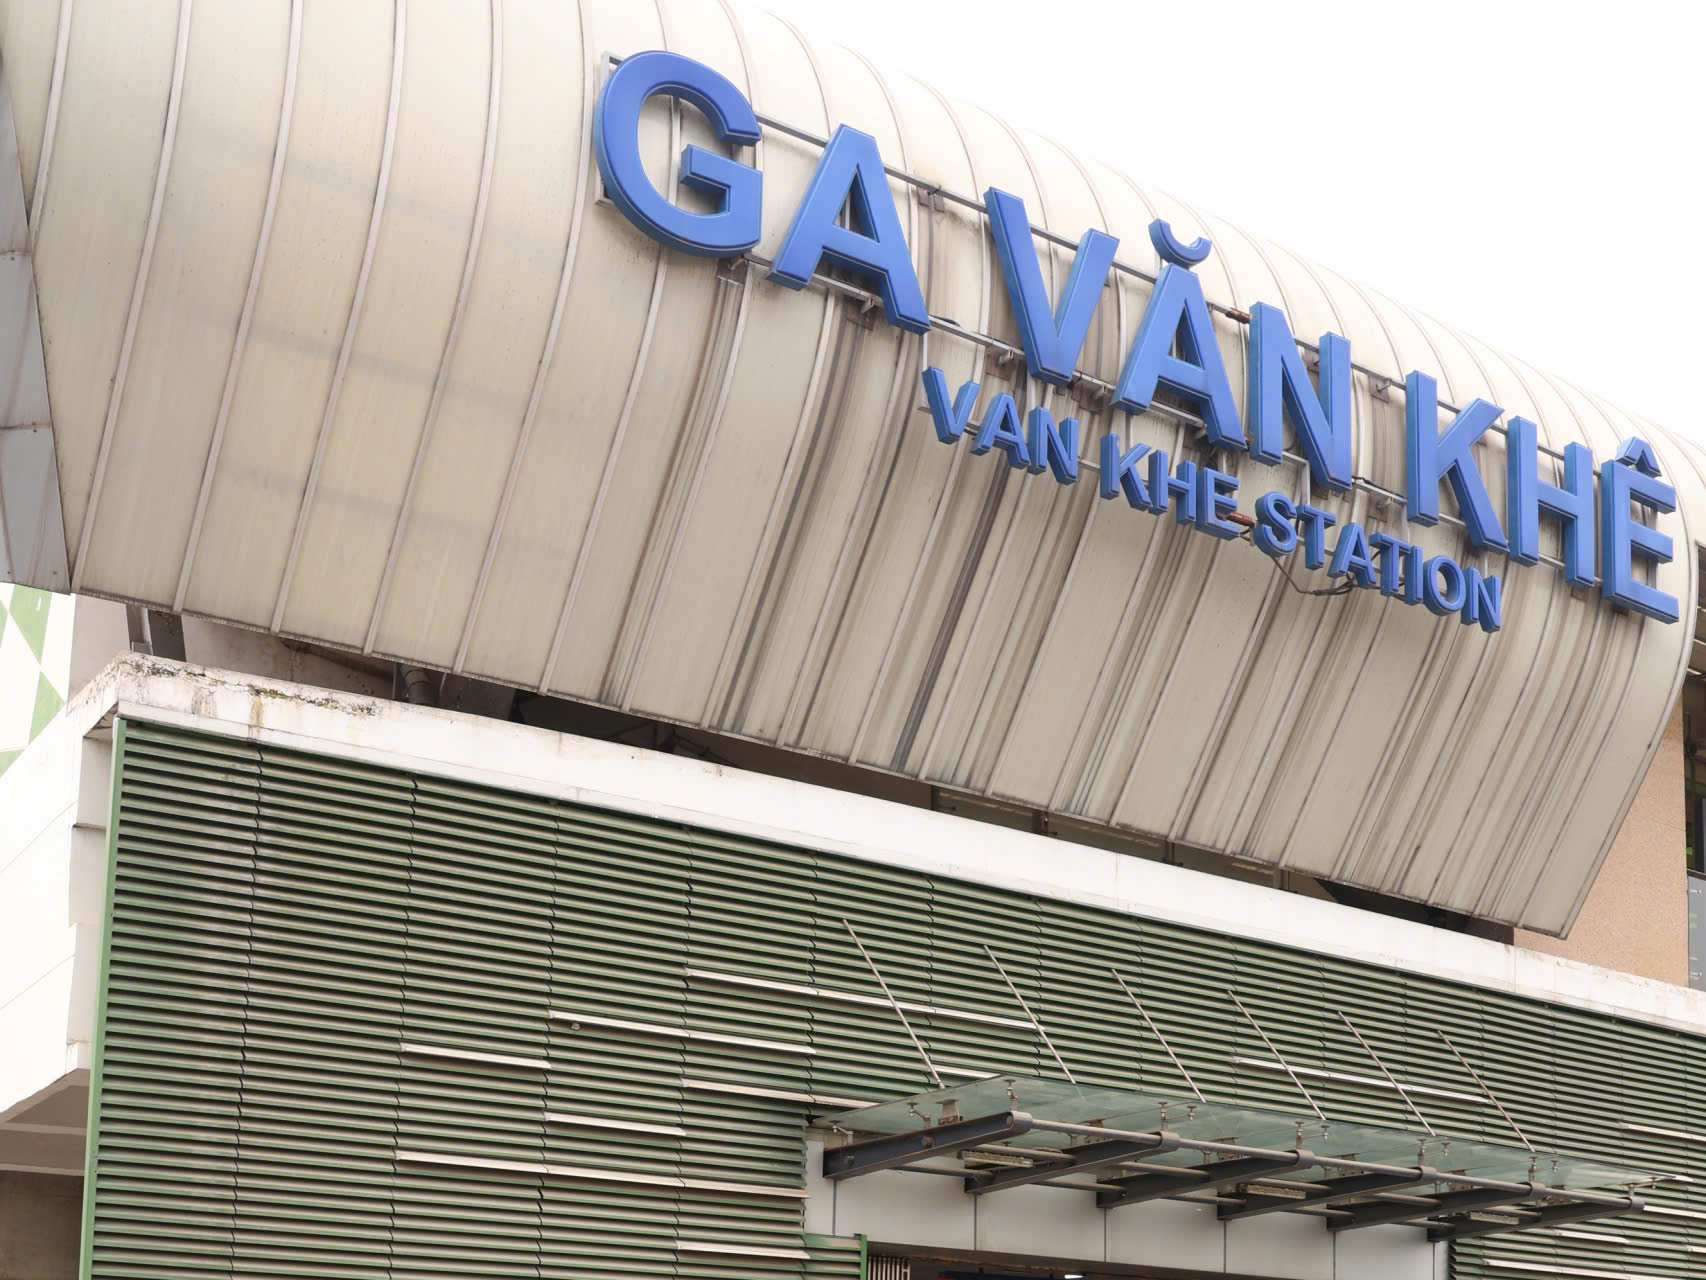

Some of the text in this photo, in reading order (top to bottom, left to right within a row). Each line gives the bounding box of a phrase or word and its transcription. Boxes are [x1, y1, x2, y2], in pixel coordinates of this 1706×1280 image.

[595, 52, 1678, 622] GA VĂN KHÊ
[923, 367, 1501, 632] VAN KHE STATION
